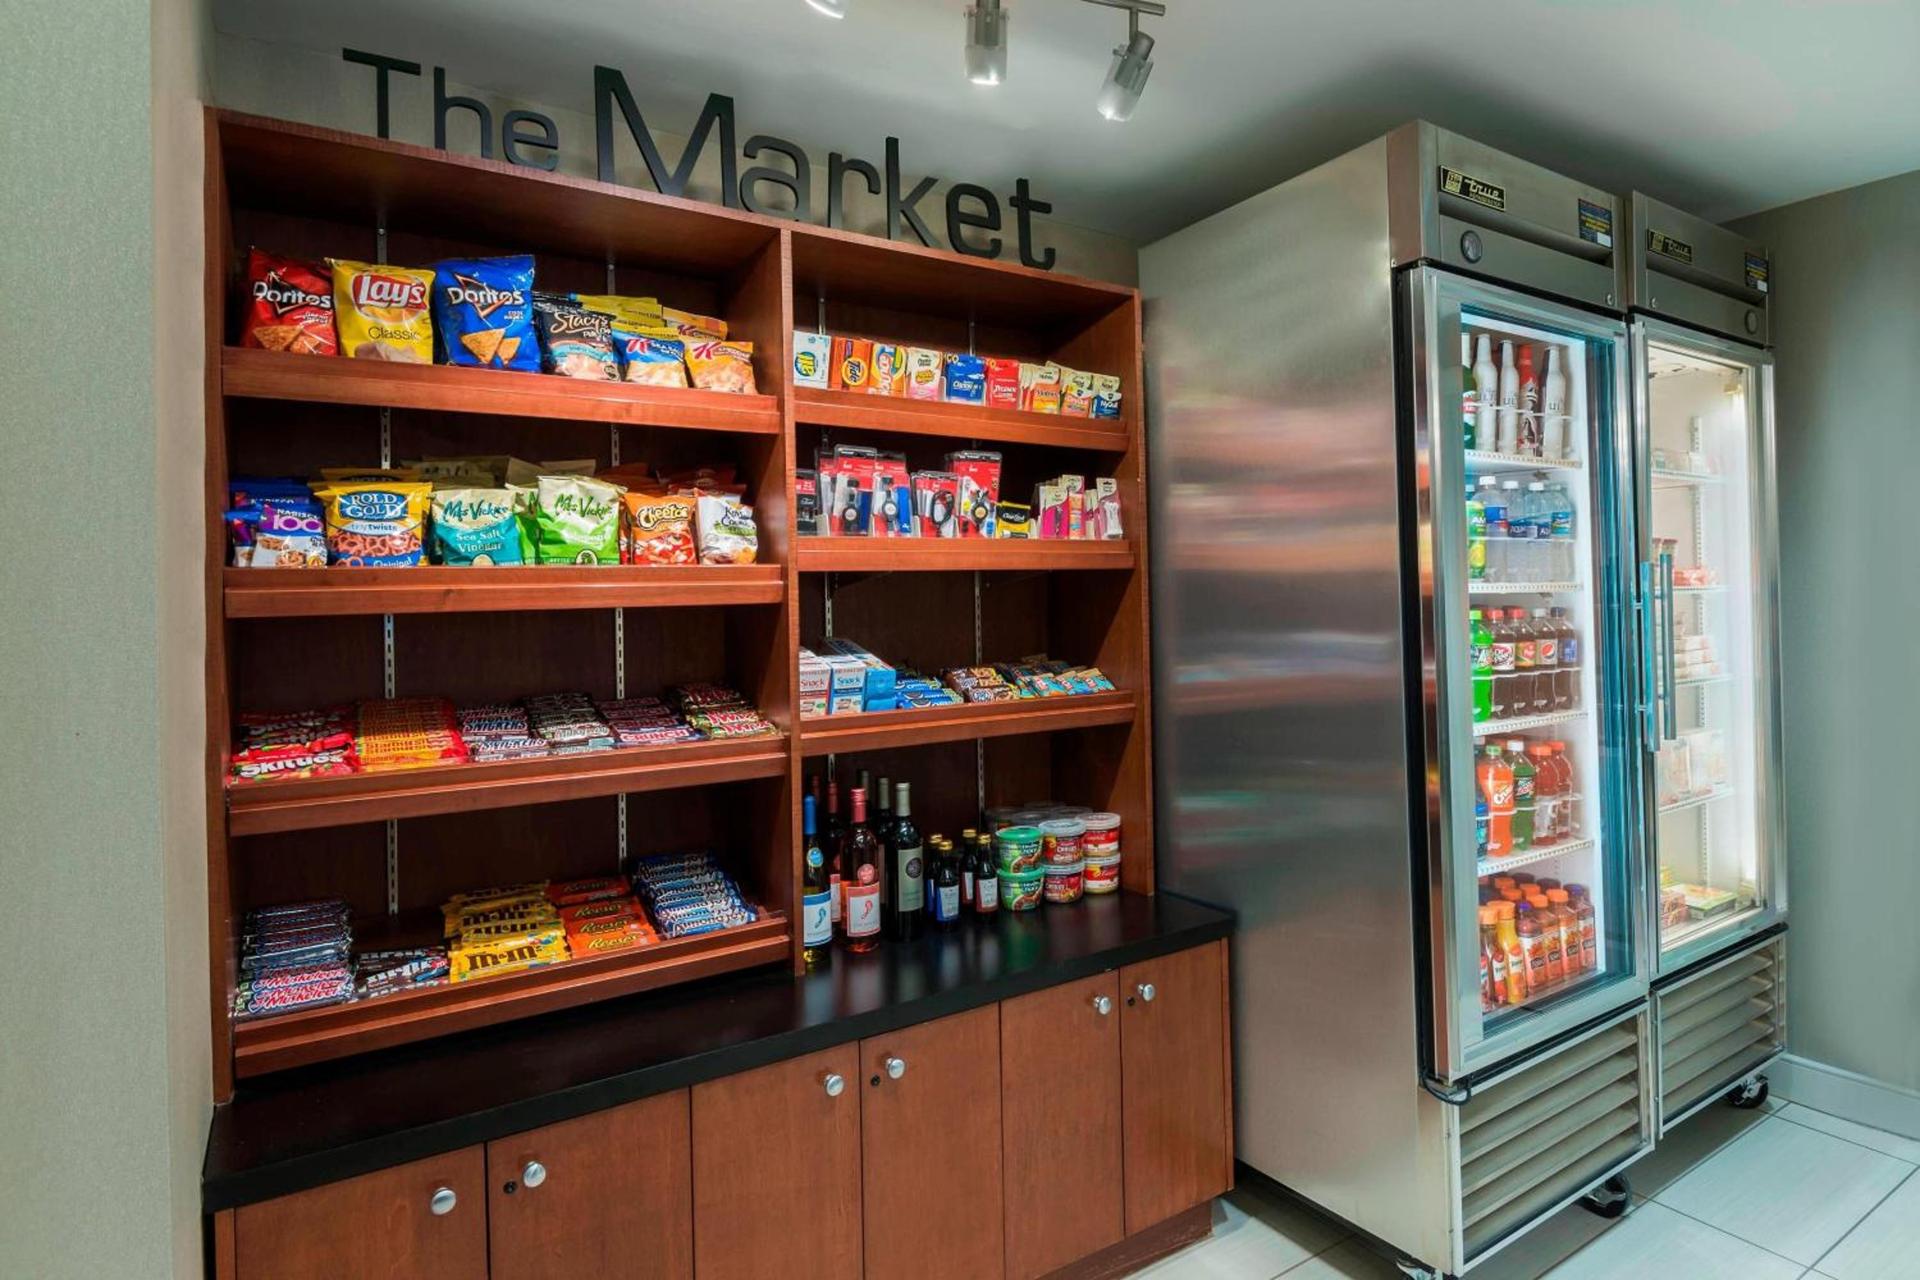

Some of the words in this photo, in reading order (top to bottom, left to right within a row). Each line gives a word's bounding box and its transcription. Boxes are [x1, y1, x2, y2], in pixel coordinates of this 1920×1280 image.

[343, 48, 559, 171] The
[594, 65, 1056, 270] Market
[253, 281, 331, 309] Doritos
[359, 276, 426, 309] Lay's
[447, 287, 525, 306] Doritos
[550, 311, 608, 334] Stacy's
[368, 326, 420, 342] Classic
[847, 360, 861, 383] Tide
[351, 493, 398, 506] ROLD
[345, 504, 402, 518] GOLD
[639, 504, 688, 528] Cheetos
[273, 515, 323, 532] 100
[456, 533, 477, 541] Sea
[480, 530, 501, 539] Salt
[459, 543, 502, 553] Vinegar
[622, 730, 687, 741] CRUNCH
